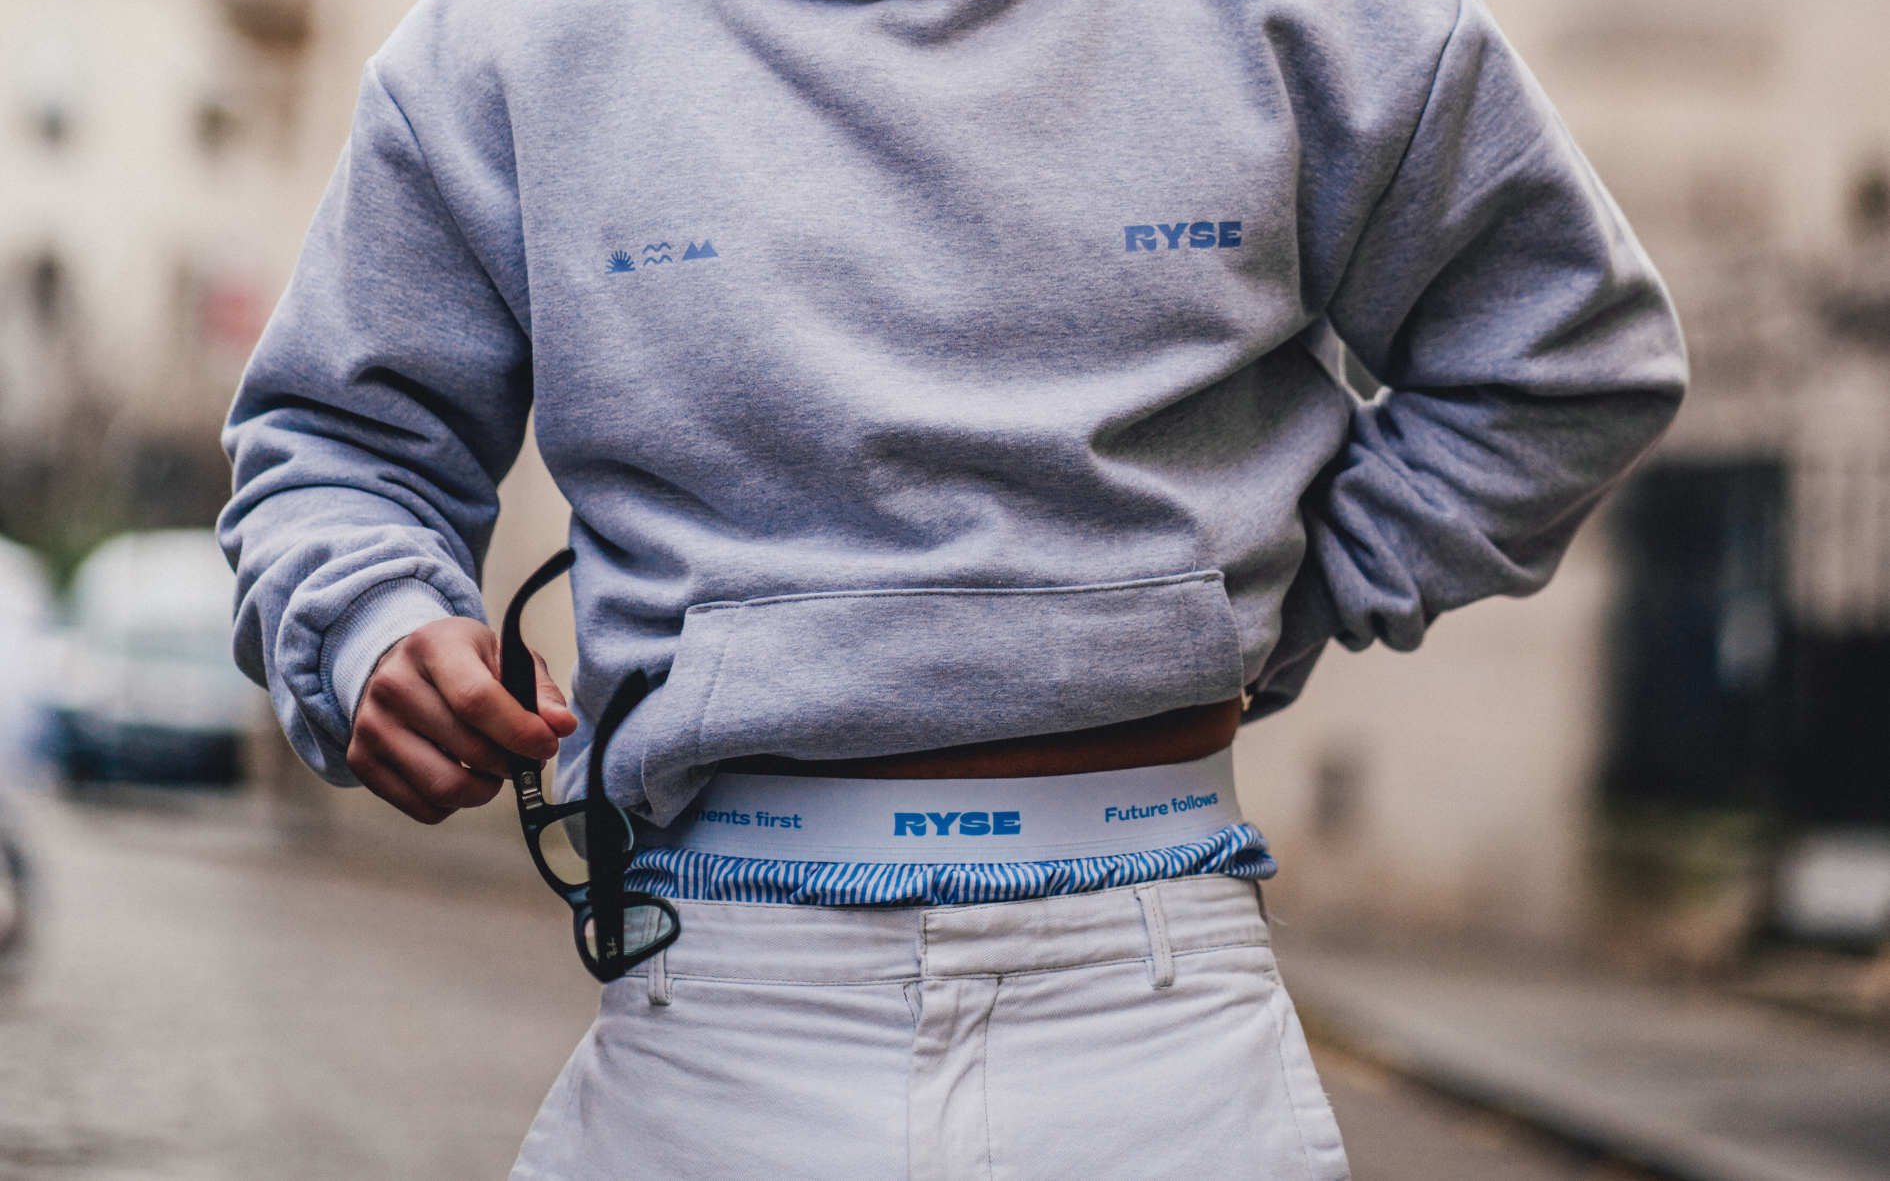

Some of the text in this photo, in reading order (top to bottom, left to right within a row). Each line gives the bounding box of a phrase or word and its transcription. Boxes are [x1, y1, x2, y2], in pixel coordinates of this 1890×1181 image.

[1124, 221, 1242, 252] RYSE
[755, 811, 802, 829] first
[1104, 791, 1218, 823] Future follows
[893, 811, 1021, 836] RYSE
